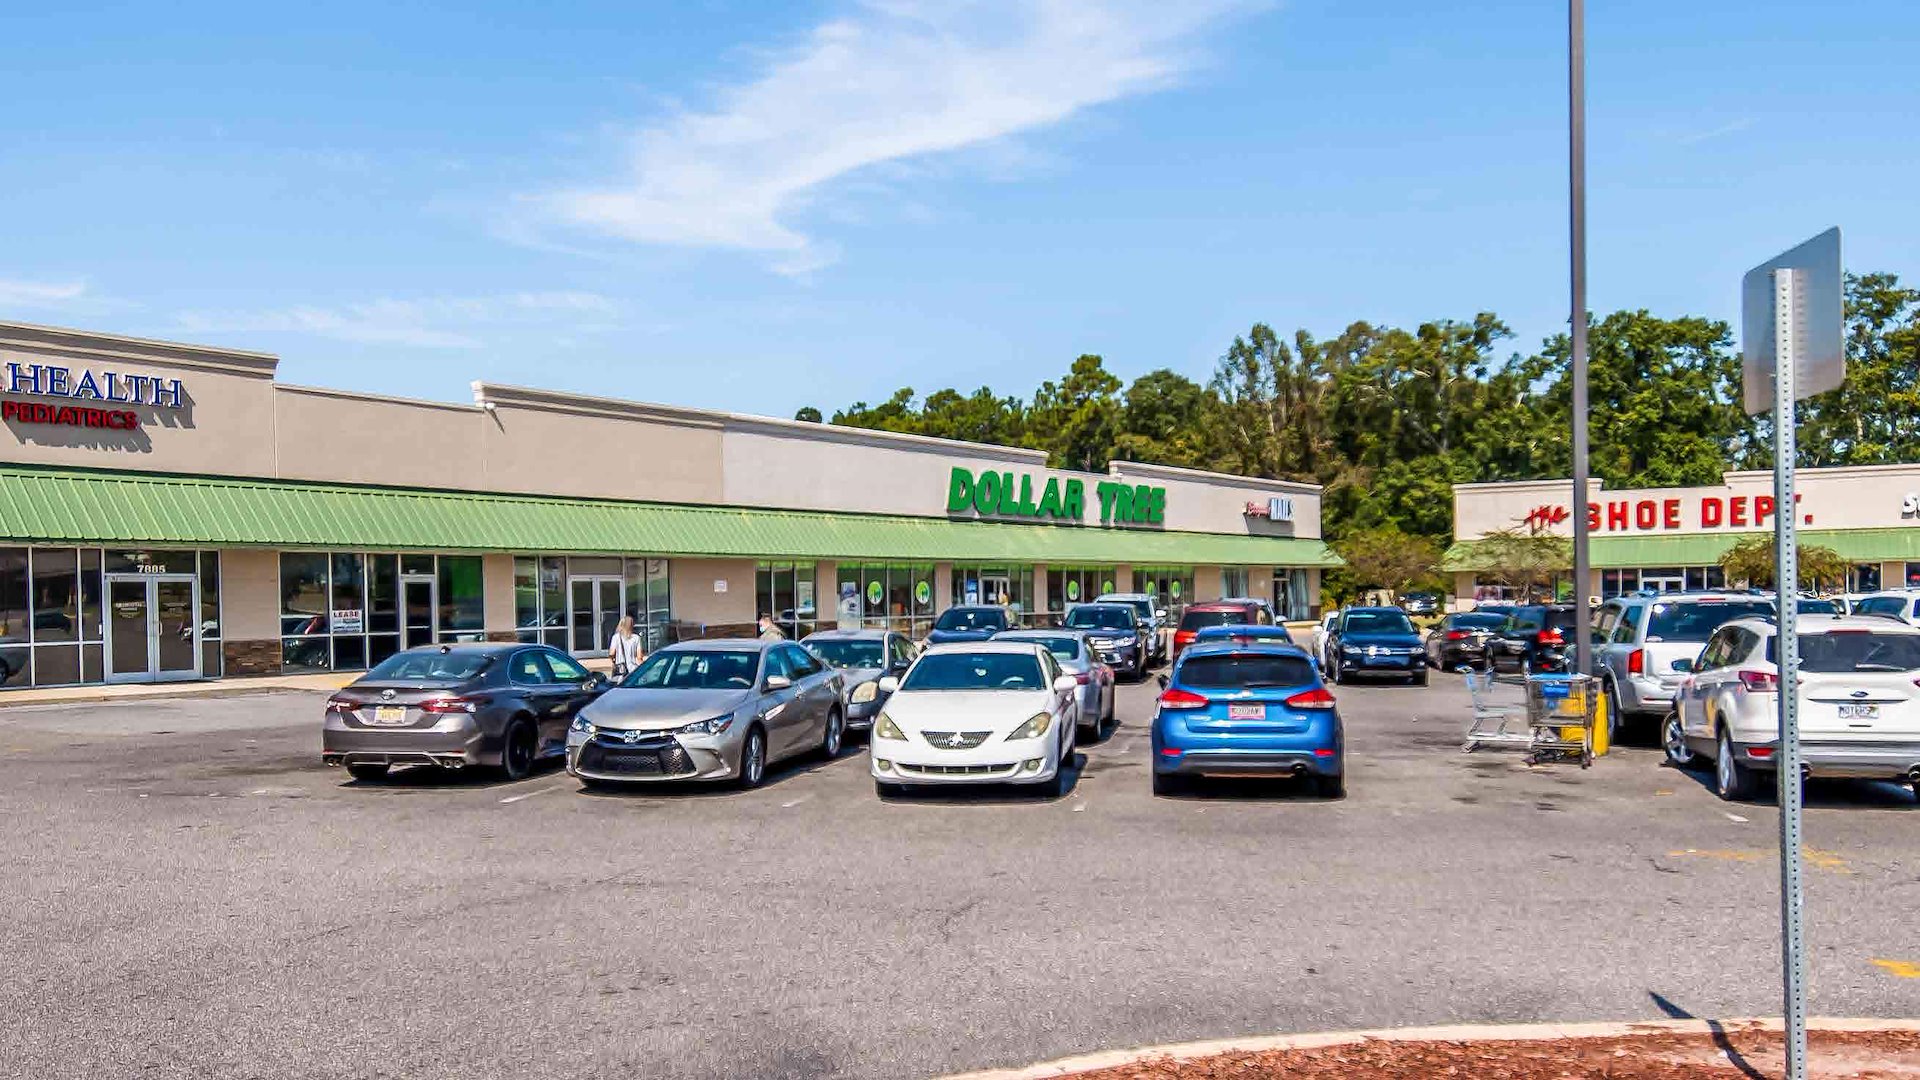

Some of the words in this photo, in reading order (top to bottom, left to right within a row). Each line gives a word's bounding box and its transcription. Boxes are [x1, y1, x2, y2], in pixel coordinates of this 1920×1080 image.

[6, 362, 182, 407] HEALTH
[2, 400, 139, 431] PEDIATRICS
[949, 466, 1084, 520] DOLLAR
[1096, 480, 1166, 523] TREE
[1523, 505, 1570, 536] the
